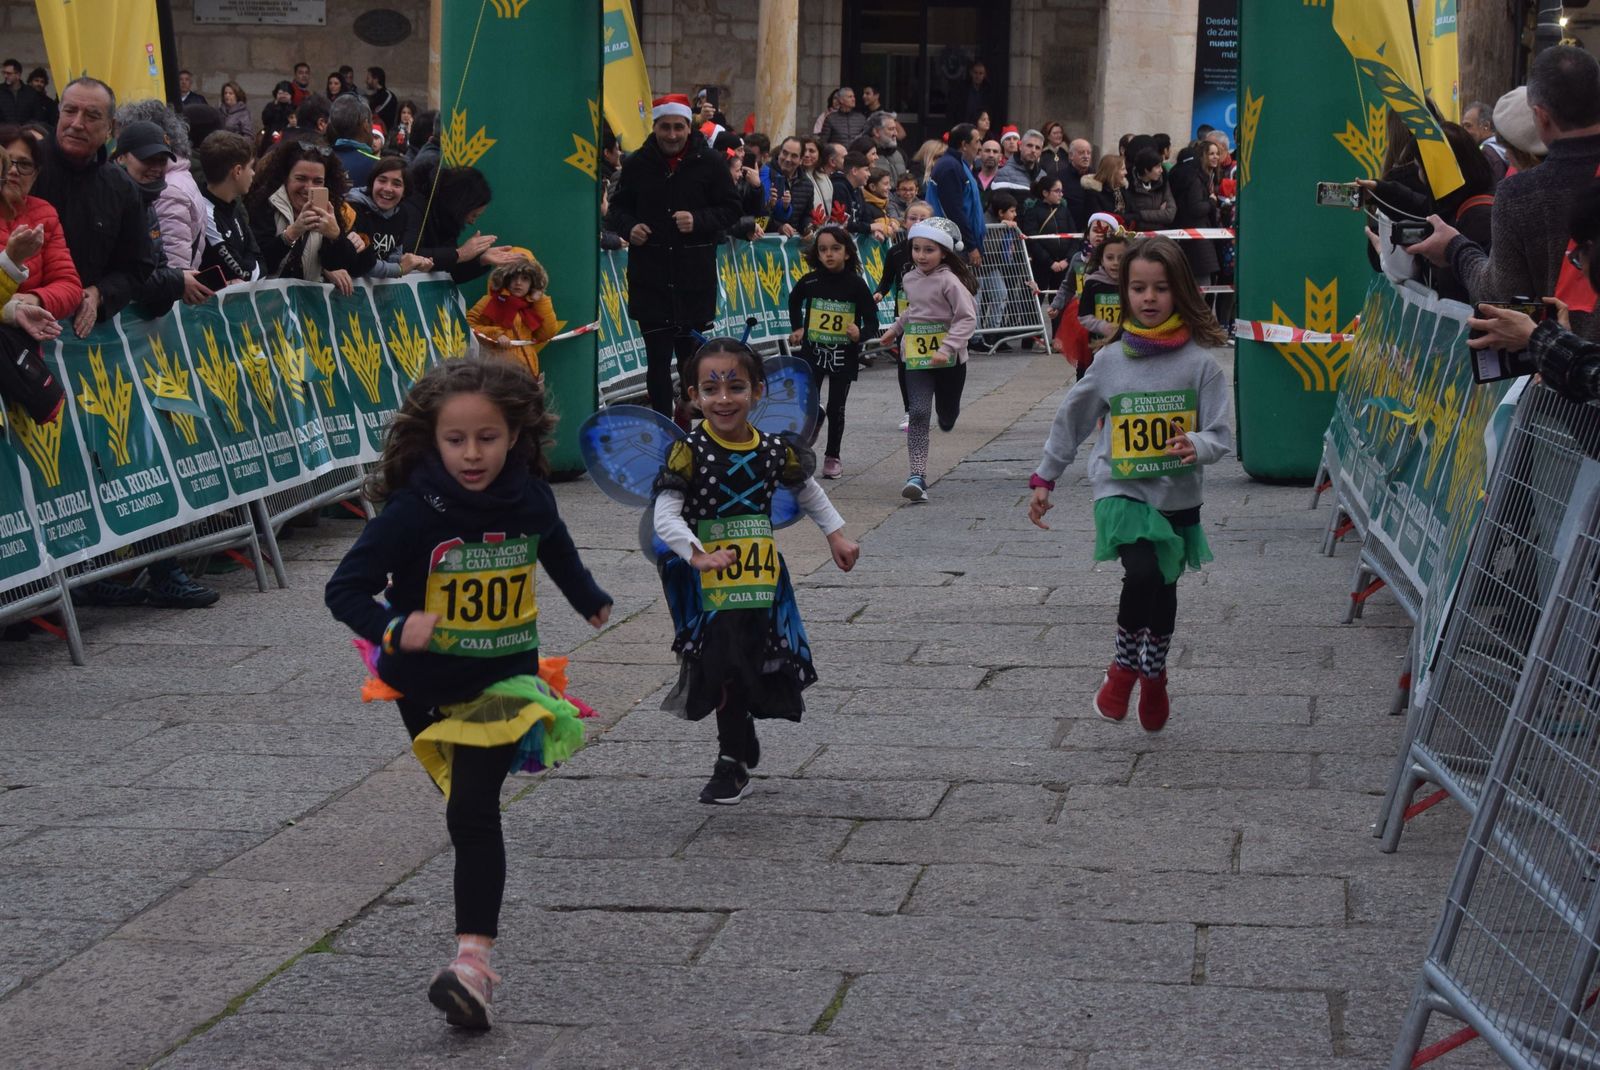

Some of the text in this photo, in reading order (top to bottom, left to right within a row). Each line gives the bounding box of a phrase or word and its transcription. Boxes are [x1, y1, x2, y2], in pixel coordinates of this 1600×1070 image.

[1205, 17, 1230, 25] Desde
[1207, 28, 1217, 36] de
[819, 313, 844, 332] 28
[916, 335, 940, 355] 34
[1134, 395, 1185, 405] FUNDACION
[1135, 402, 1186, 412] CAJA RURAL
[176, 457, 198, 477] CAJA
[1135, 463, 1160, 472] CAJA
[99, 466, 169, 504] CAJA RURAL
[54, 490, 92, 519] RURAL
[116, 492, 164, 517] DE ZAMORA
[57, 518, 87, 537] ZAMORA
[727, 528, 750, 538] CAJA
[466, 543, 528, 559] FUNDACION
[466, 554, 528, 570] CAJA RURAL
[440, 573, 528, 622] 1307
[729, 592, 753, 602] CAJA
[460, 630, 533, 650] CAJA RURAL
